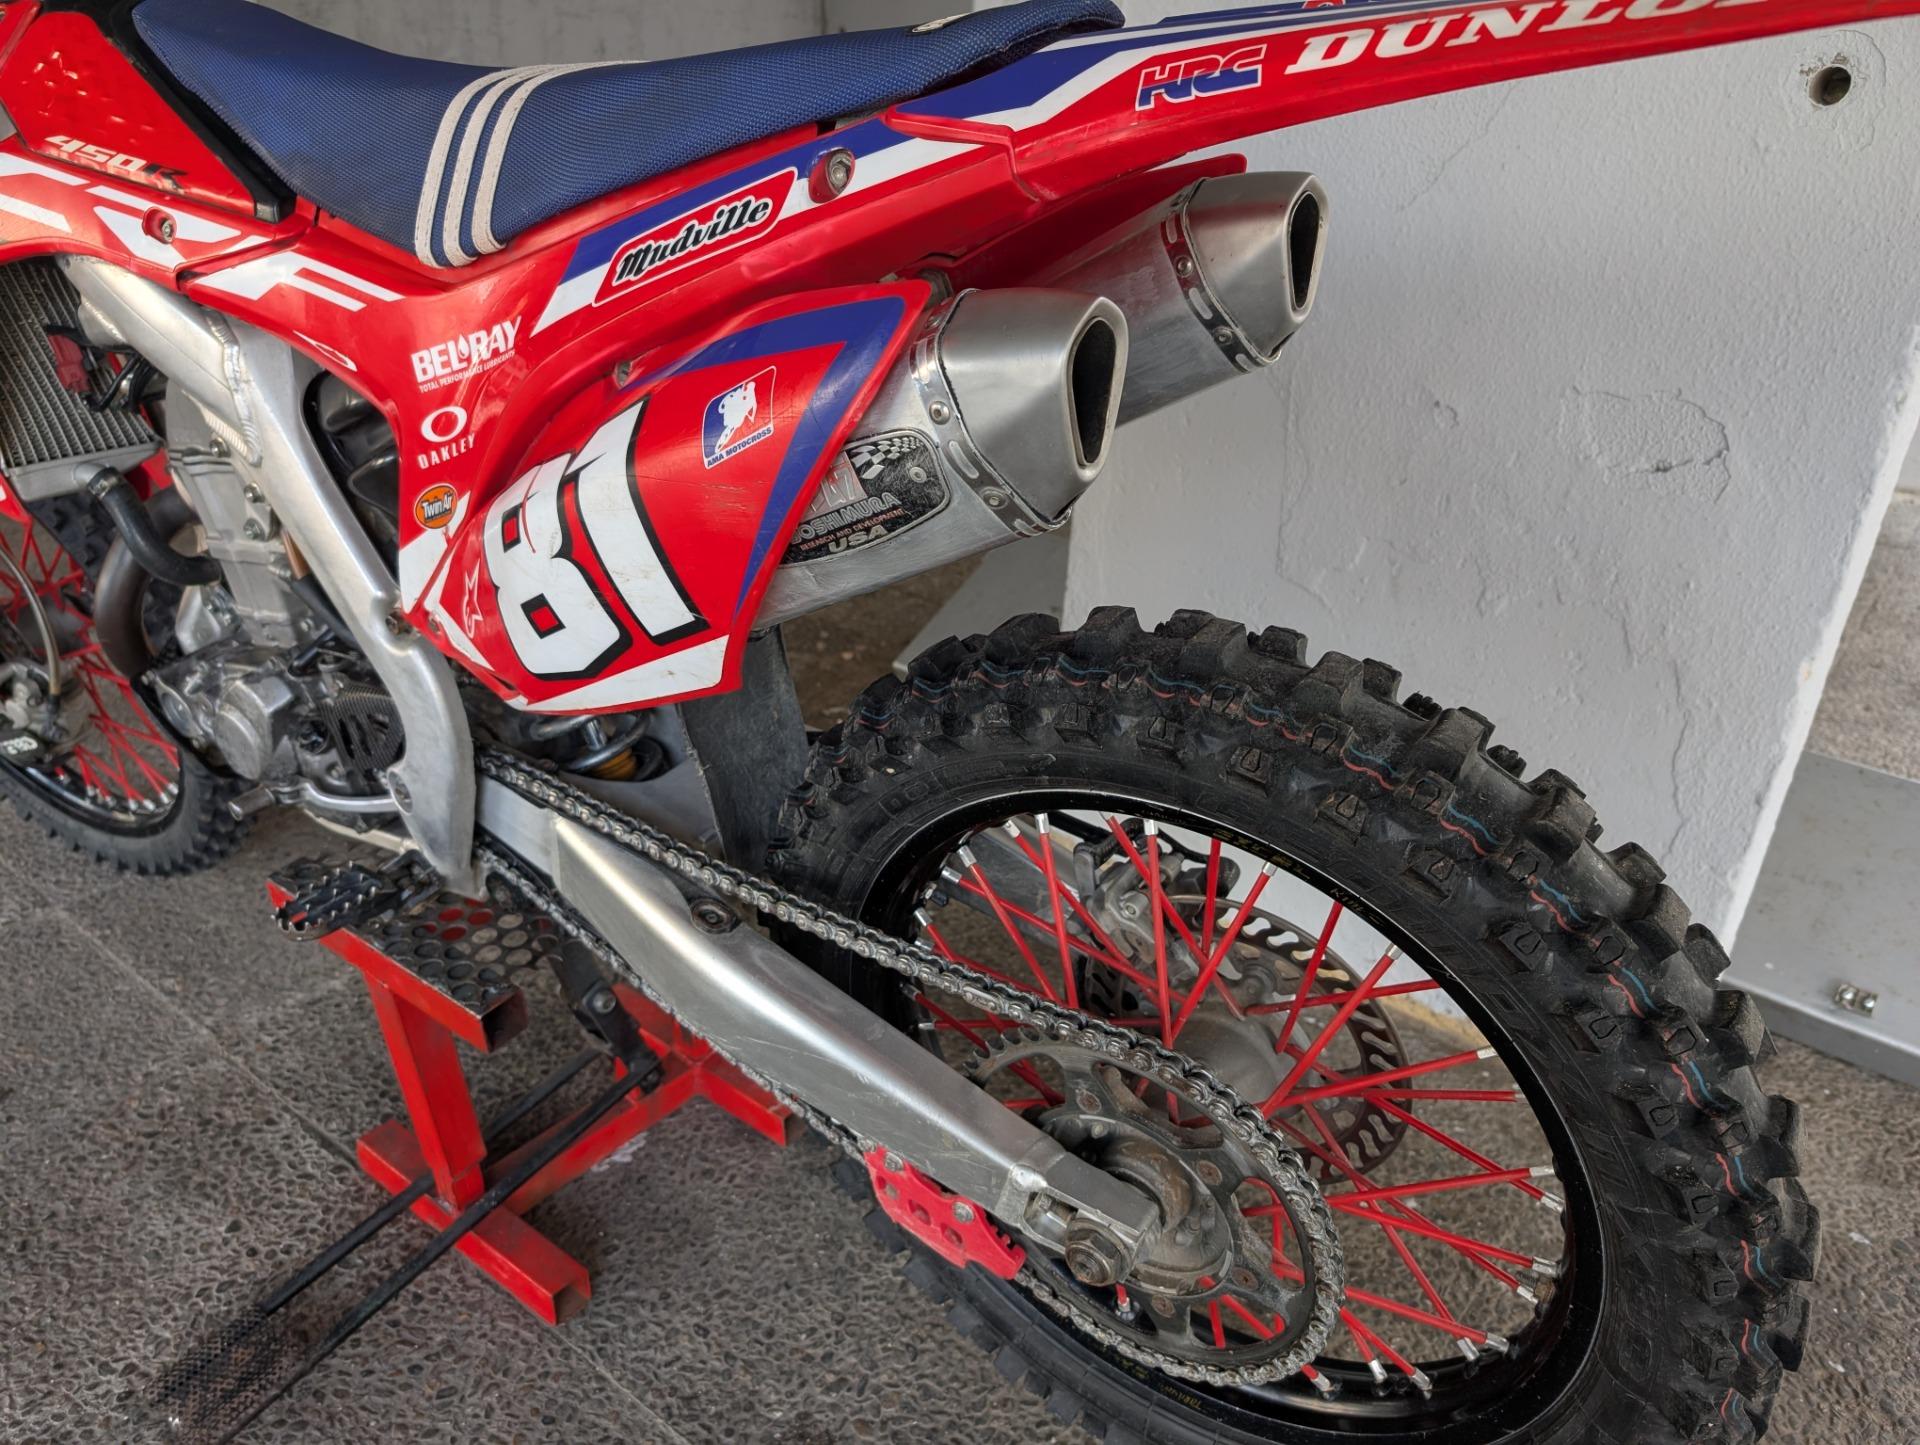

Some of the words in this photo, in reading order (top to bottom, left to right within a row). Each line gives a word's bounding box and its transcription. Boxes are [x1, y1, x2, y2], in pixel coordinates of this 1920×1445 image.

[1285, 0, 1770, 74] DUNLO
[1135, 44, 1267, 111] HRC
[613, 196, 772, 285] Mudville
[419, 380, 440, 394] TOTAL
[417, 433, 476, 470] OAKLEY
[707, 453, 725, 468] AMA
[725, 427, 772, 456] MOTOCROSS
[483, 394, 711, 682] 81
[828, 524, 889, 553] USA
[836, 528, 853, 539] AND
